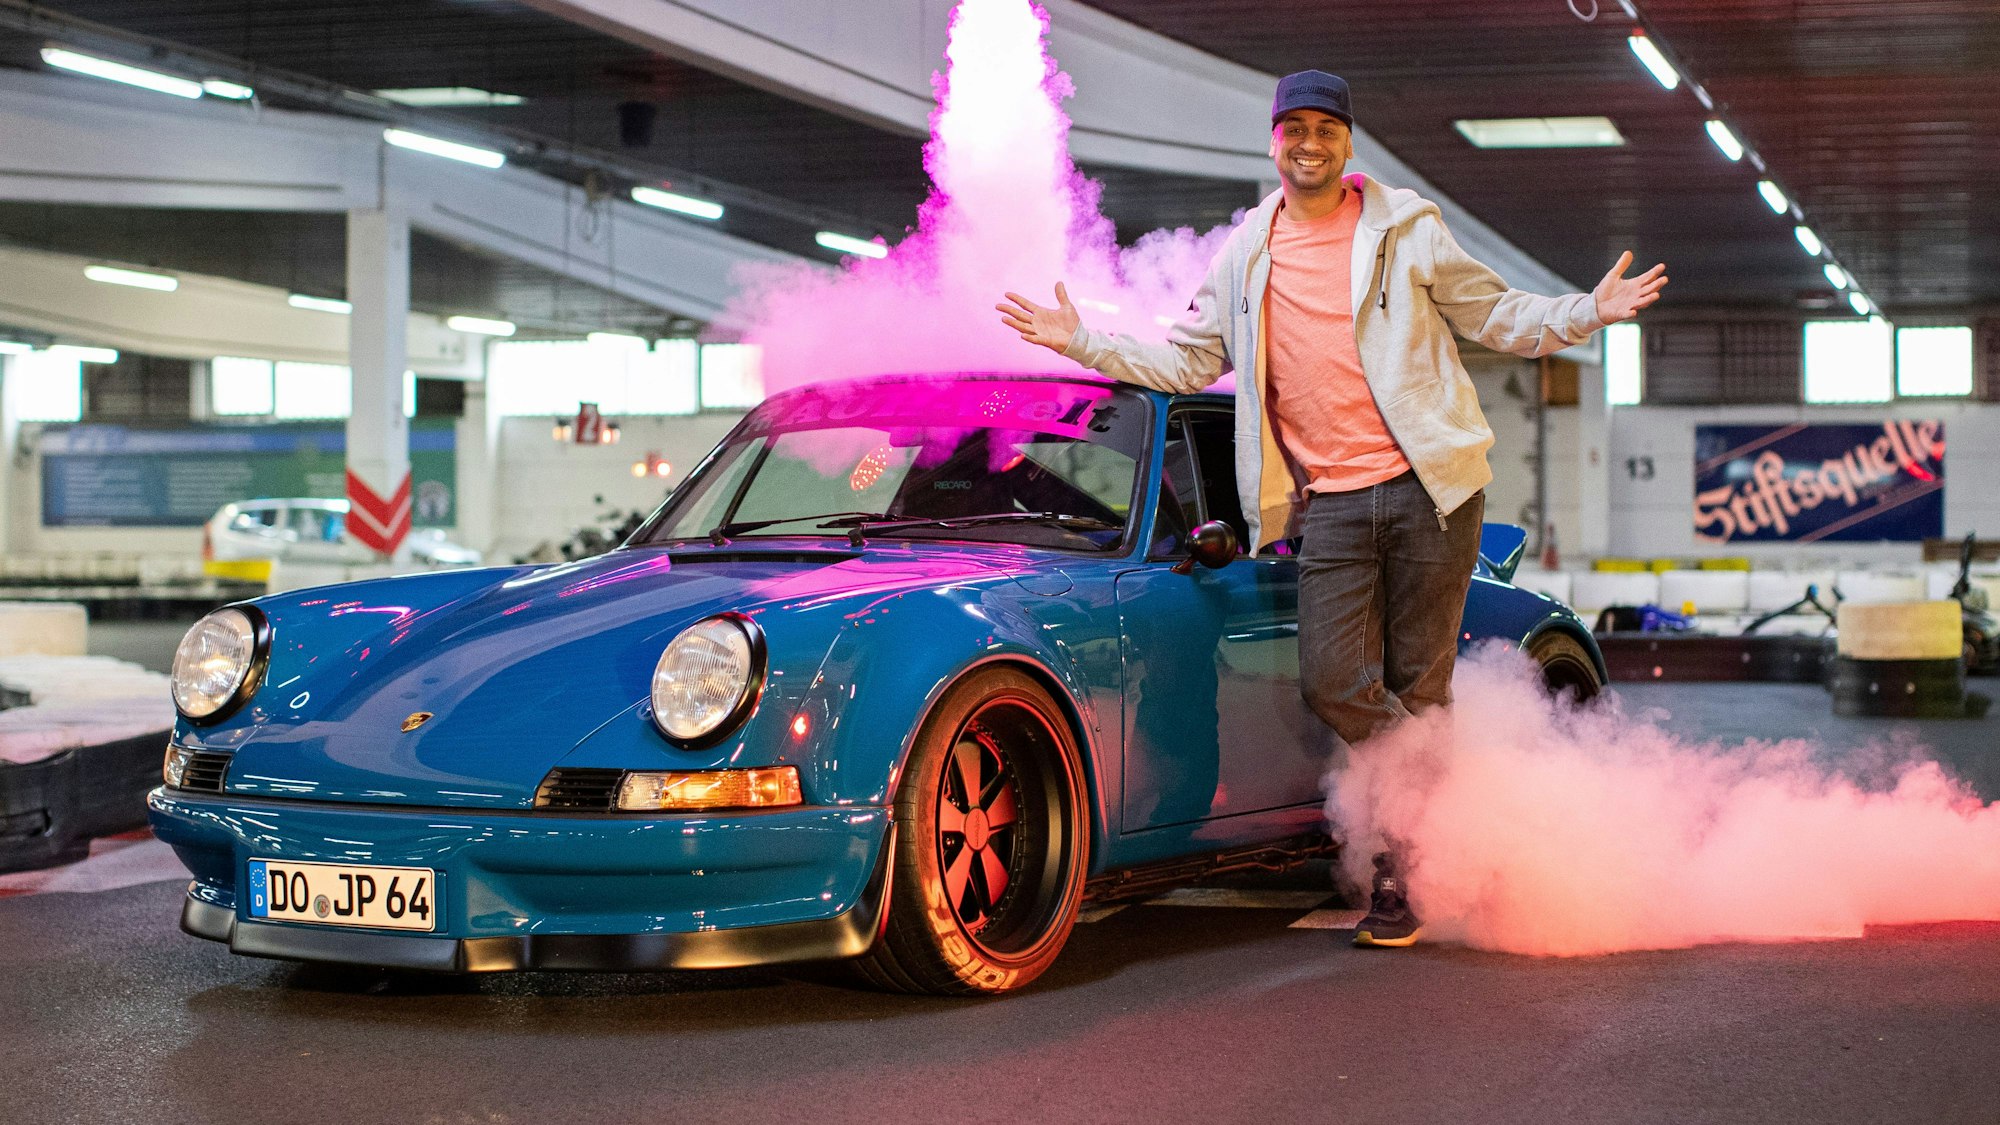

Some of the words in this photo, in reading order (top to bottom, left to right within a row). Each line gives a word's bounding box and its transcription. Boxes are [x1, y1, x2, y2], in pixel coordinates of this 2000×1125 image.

[1626, 456, 1655, 480] 13
[255, 894, 264, 907] D
[269, 870, 309, 913] DO
[333, 873, 376, 917] JP
[386, 876, 430, 920] 64
